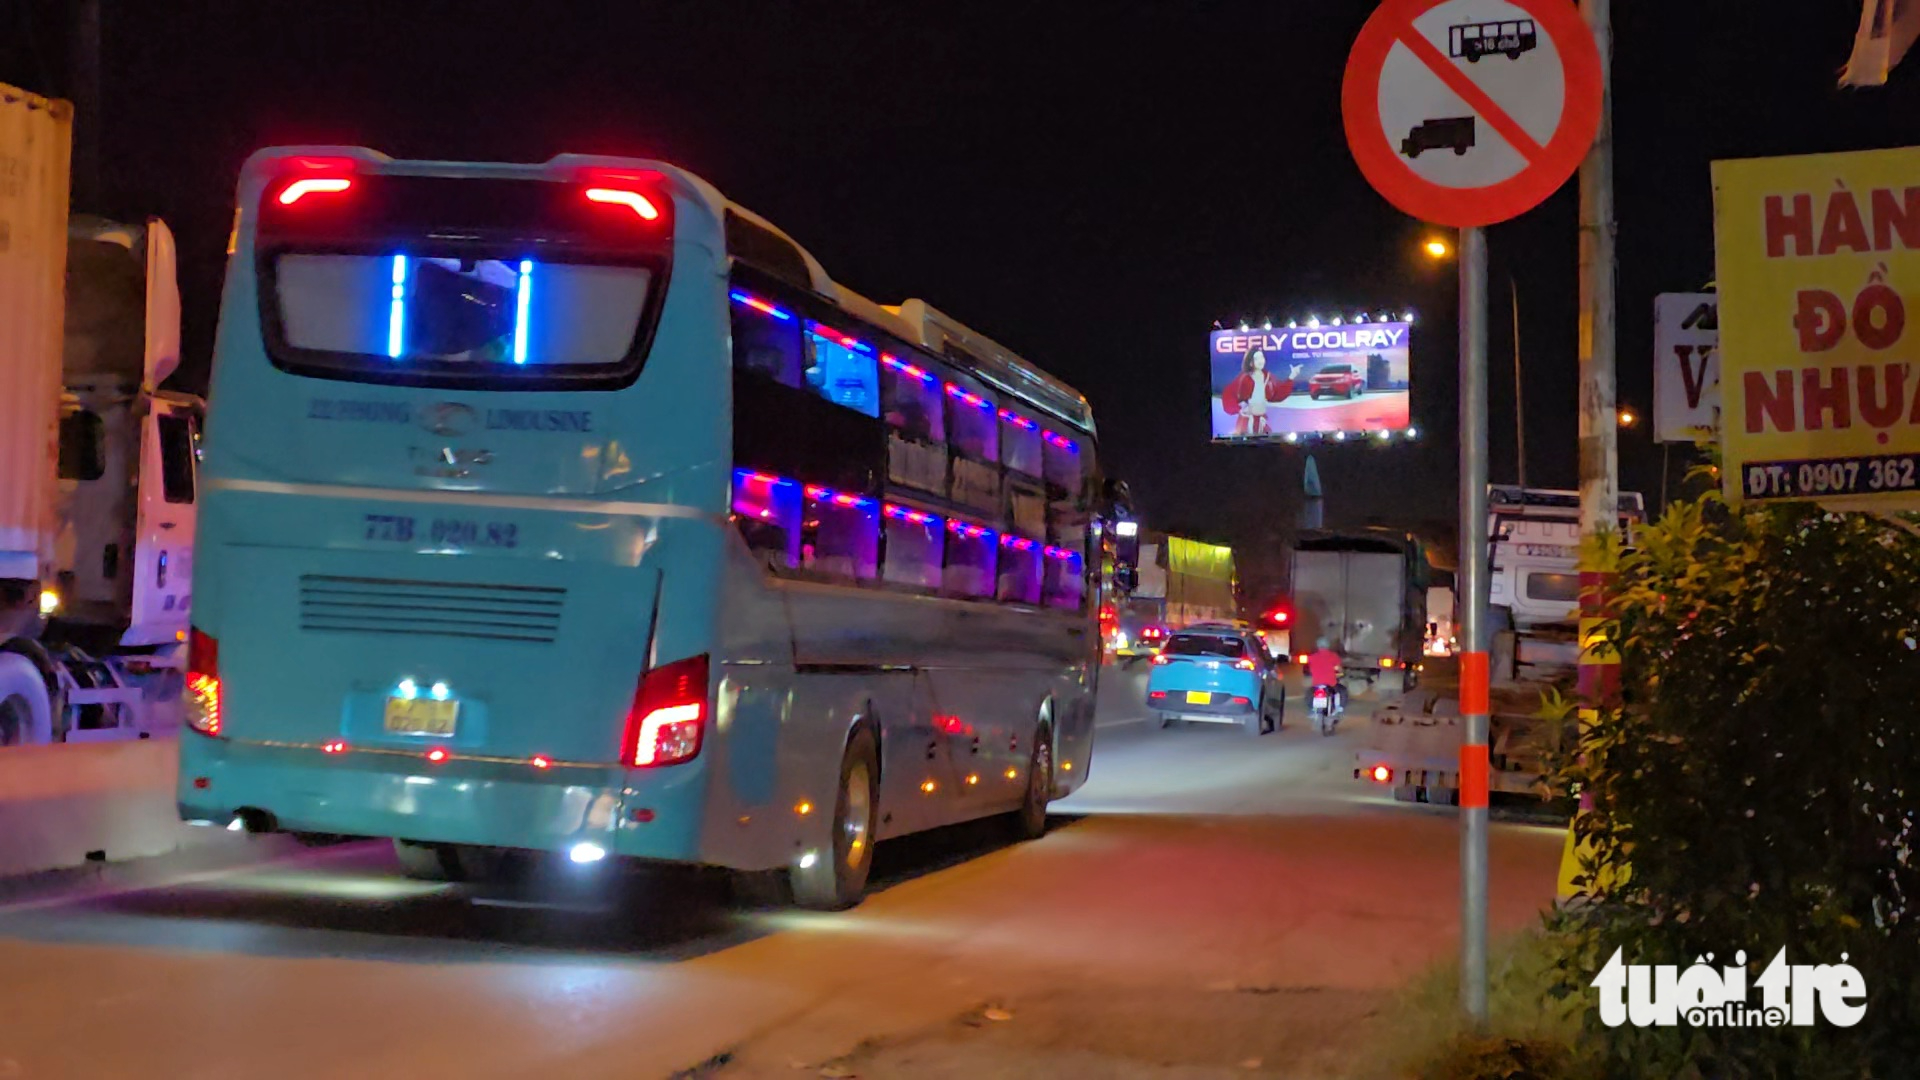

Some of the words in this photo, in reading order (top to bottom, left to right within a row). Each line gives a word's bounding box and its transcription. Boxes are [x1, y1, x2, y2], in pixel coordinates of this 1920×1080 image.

[1794, 262, 1905, 352] ĐỒ
[1216, 333, 1288, 353] GEELY
[1292, 328, 1403, 349] COOLRAY
[486, 408, 592, 432] LIMOUSINE
[1744, 362, 1920, 444] NHỰ
[1749, 466, 1791, 495] ĐT:
[1799, 462, 1859, 492] 0907
[1868, 457, 1915, 489] 362
